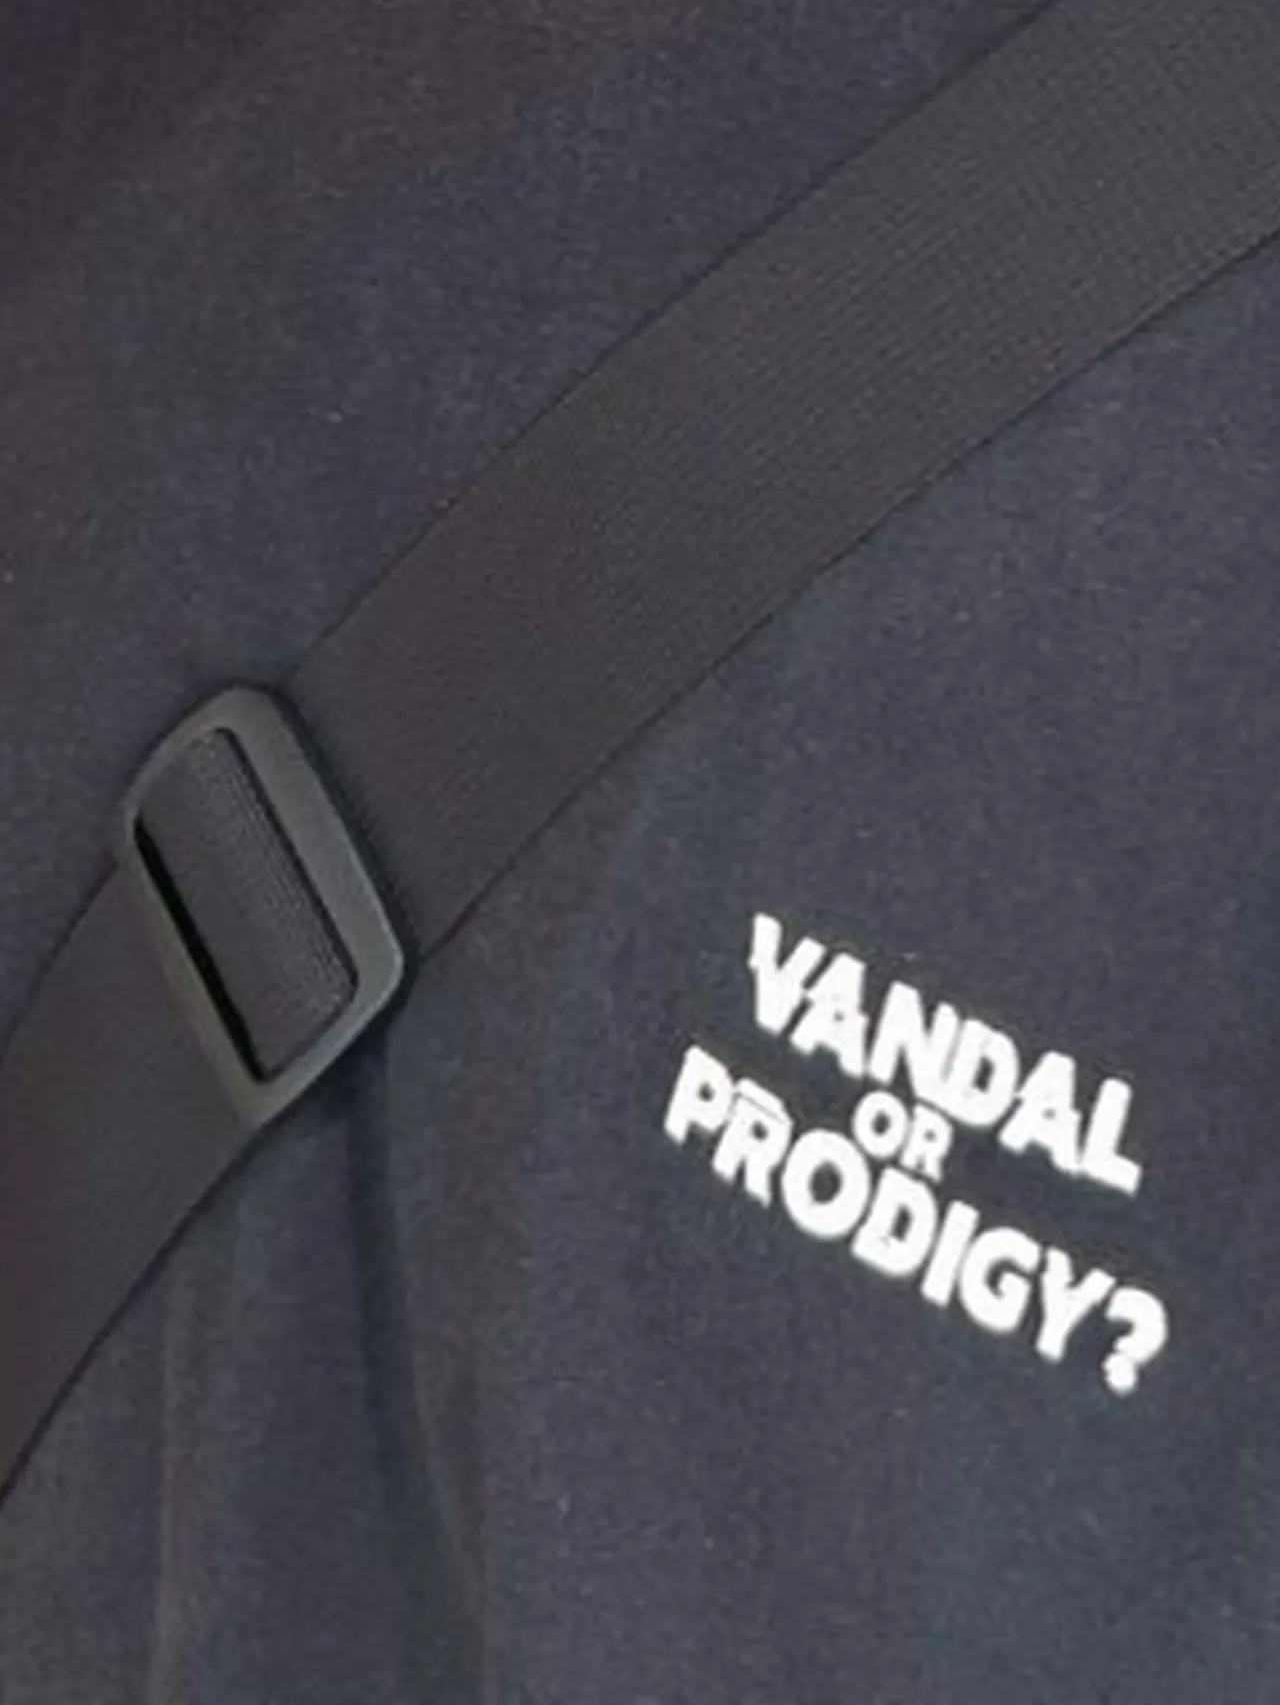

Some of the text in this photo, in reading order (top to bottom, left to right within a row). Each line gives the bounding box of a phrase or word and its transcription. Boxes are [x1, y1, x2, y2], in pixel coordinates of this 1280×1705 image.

[749, 913, 1141, 1193] VANDAL
[853, 1091, 952, 1181] OR
[665, 1046, 1166, 1393] PRODIGY?
